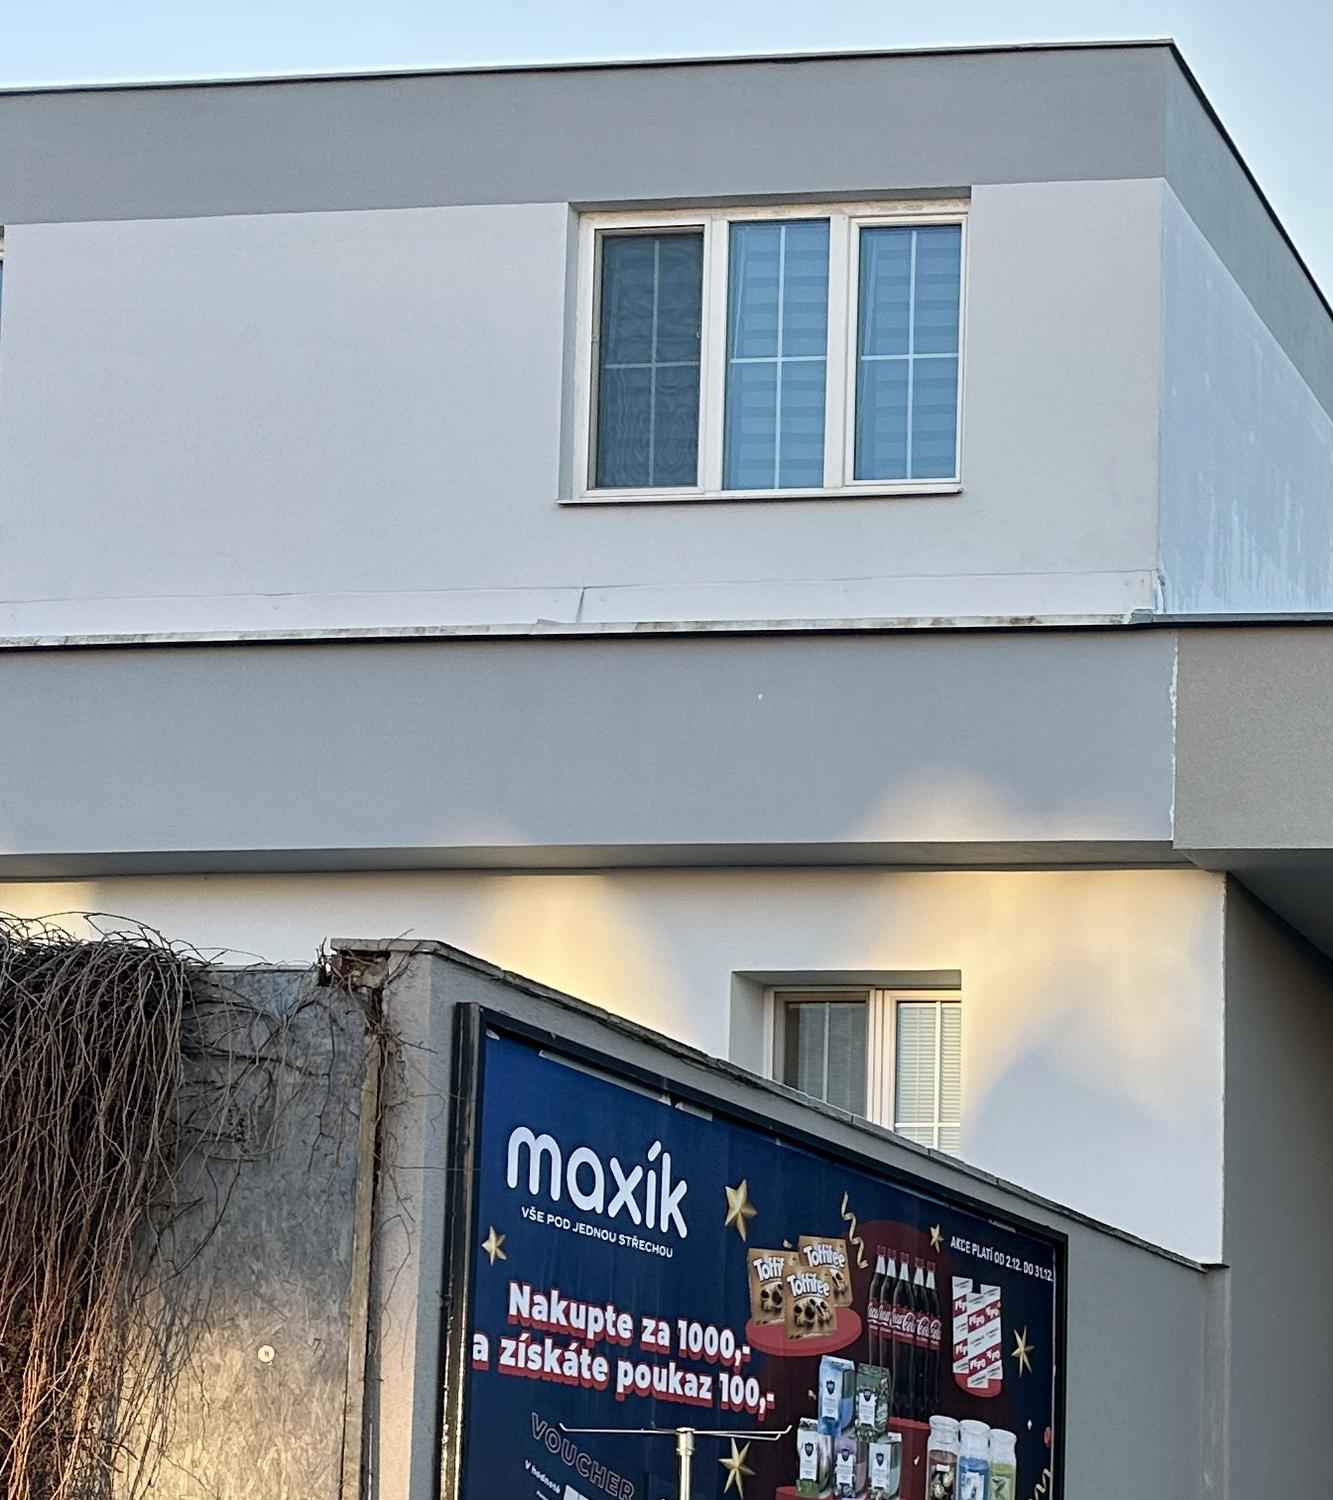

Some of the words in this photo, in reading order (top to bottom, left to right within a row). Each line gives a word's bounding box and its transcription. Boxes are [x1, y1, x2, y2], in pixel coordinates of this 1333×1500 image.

[506, 1126, 688, 1238] maxík
[521, 1205, 544, 1223] VŠE
[546, 1213, 571, 1229] POD
[572, 1221, 617, 1243] JEDNOU
[618, 1234, 674, 1258] STŘECHOU
[803, 1244, 845, 1268] Toffifee
[786, 1272, 831, 1297] Toffifee
[950, 1235, 971, 1254] AKCE
[971, 1243, 994, 1262] PLATÍ
[994, 1250, 1005, 1266] OD
[1005, 1255, 1022, 1271] 2.12.
[1023, 1261, 1034, 1275] DO
[1034, 1265, 1054, 1282] 31.12.
[507, 1281, 635, 1343] Nakupte
[641, 1316, 671, 1350] za
[677, 1318, 751, 1366] 1000,-
[471, 1332, 490, 1365] a
[499, 1332, 609, 1384] získáte
[615, 1360, 713, 1403] poukaz
[719, 1372, 775, 1416] 100,-
